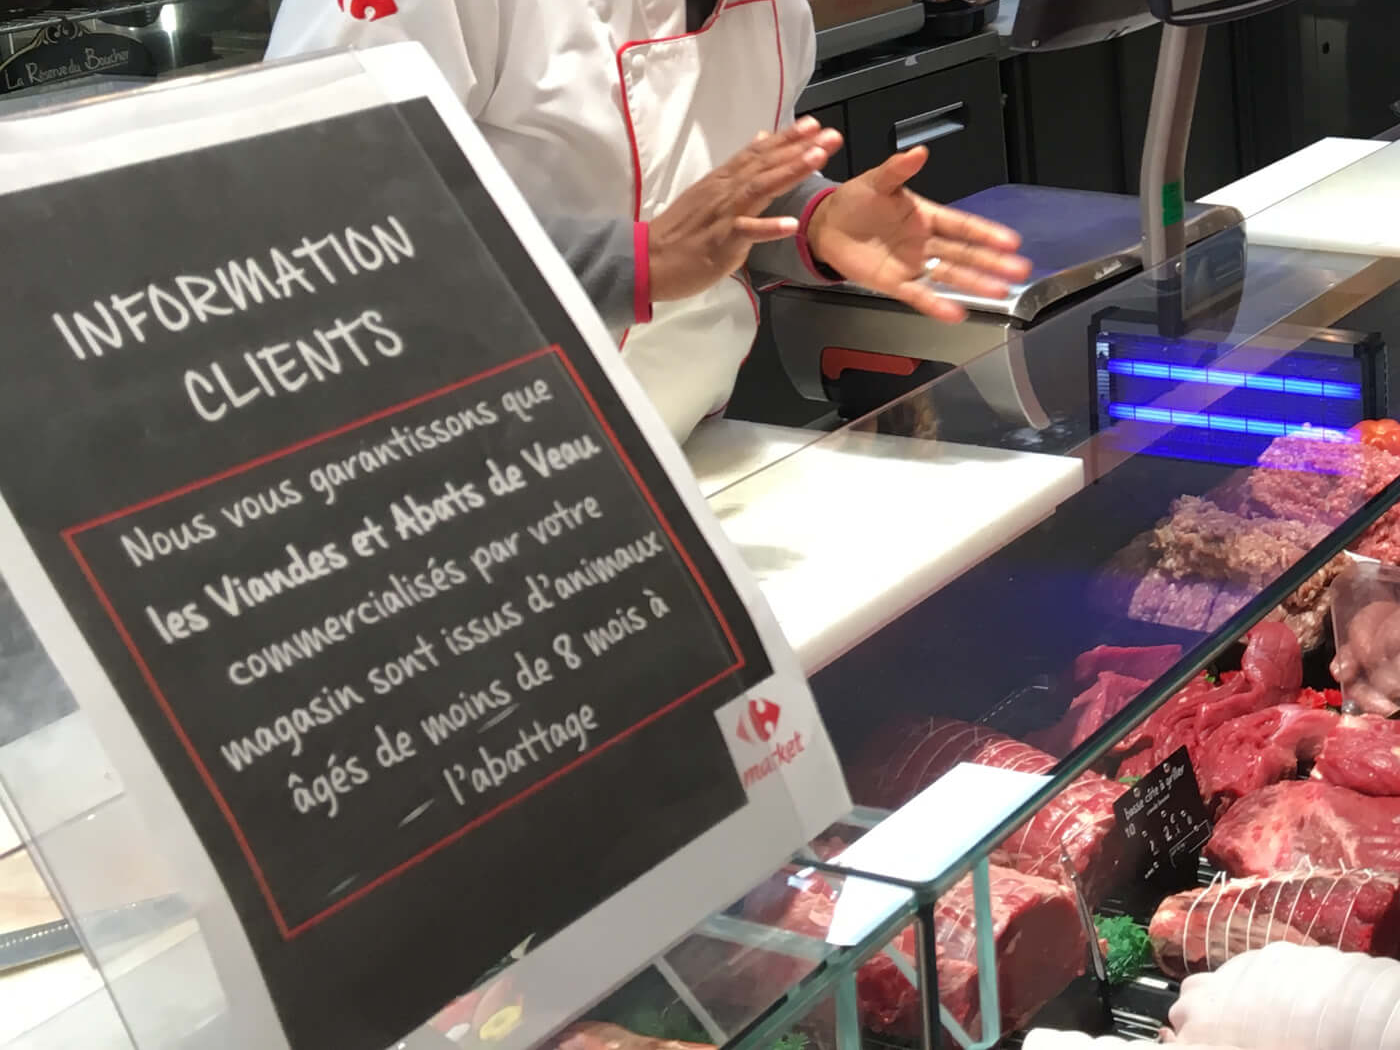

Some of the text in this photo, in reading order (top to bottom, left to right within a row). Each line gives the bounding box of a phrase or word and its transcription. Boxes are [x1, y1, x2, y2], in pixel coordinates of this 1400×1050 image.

[5, 70, 24, 90] La
[52, 215, 415, 360] INFORMATION
[183, 310, 403, 422] CLIENTS
[120, 379, 554, 567] Nous vous garantissons que
[145, 434, 601, 644] les Viandes et Abats de Veau
[220, 530, 665, 772] magasin sont issus d'animaux
[228, 495, 603, 685] commercialisés par votre
[287, 587, 671, 818] âgés de moins de 8 mois à
[442, 704, 598, 806] l'abattage
[743, 730, 805, 789] market
